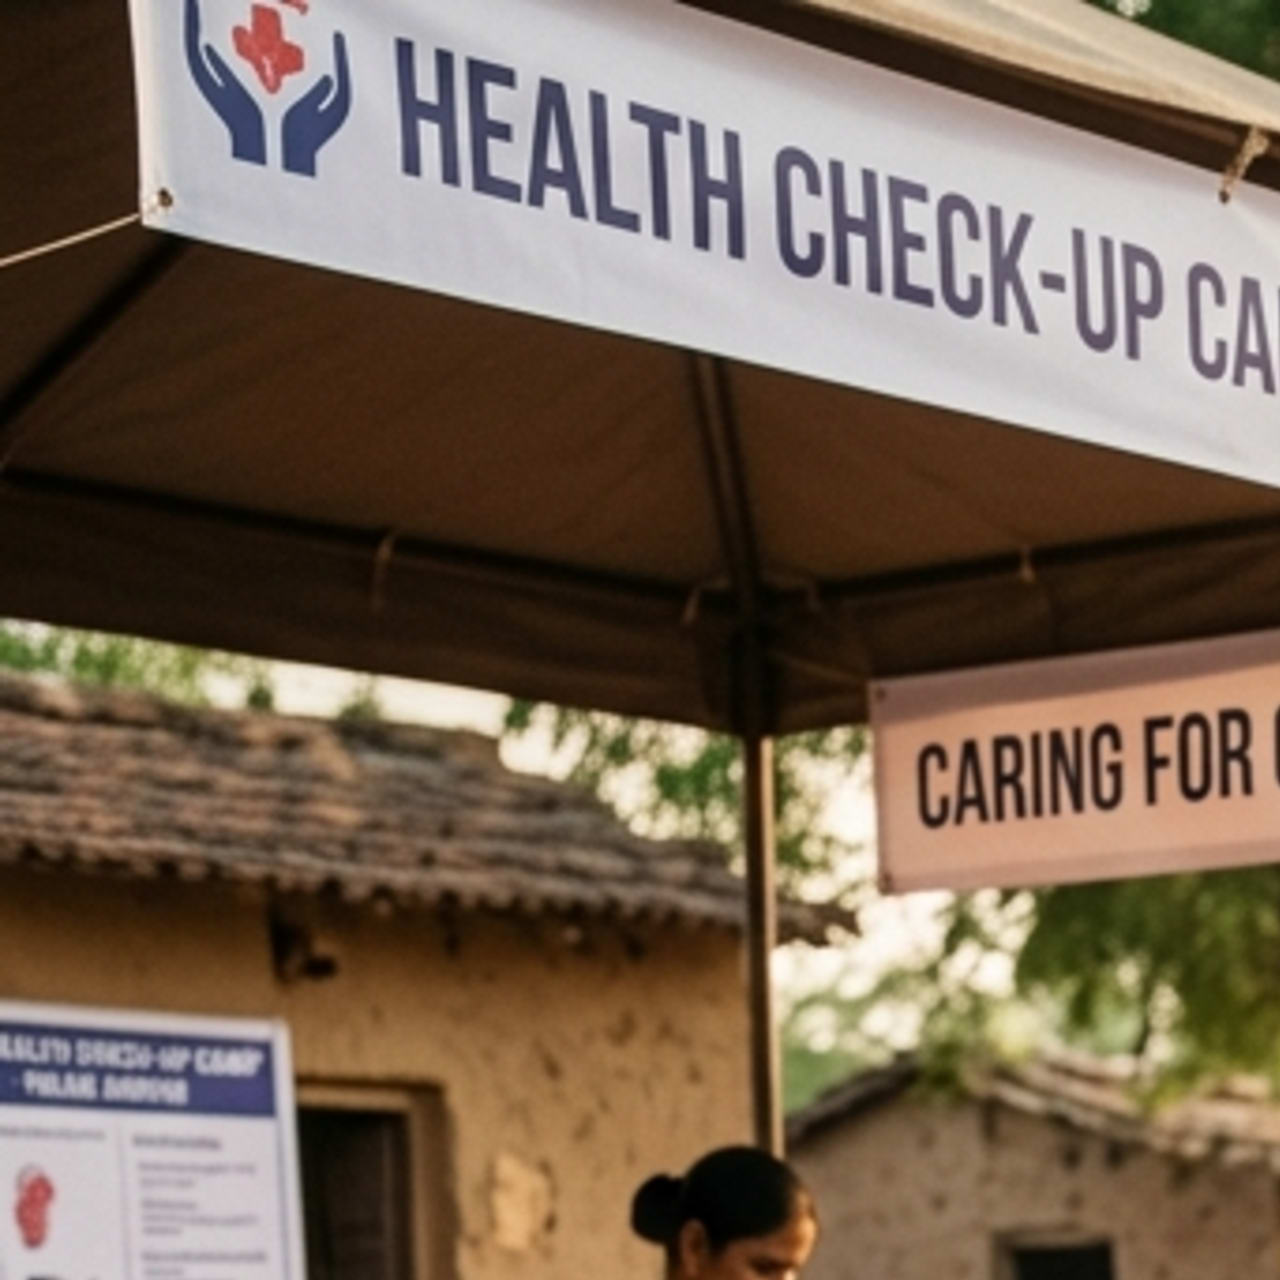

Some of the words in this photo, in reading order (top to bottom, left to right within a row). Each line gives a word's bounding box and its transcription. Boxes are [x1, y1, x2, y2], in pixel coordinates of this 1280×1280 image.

[394, 36, 747, 262] HEALTH
[774, 145, 1165, 362] CHECK-UP
[916, 721, 1124, 830] CARING
[1142, 707, 1254, 807] FOR
